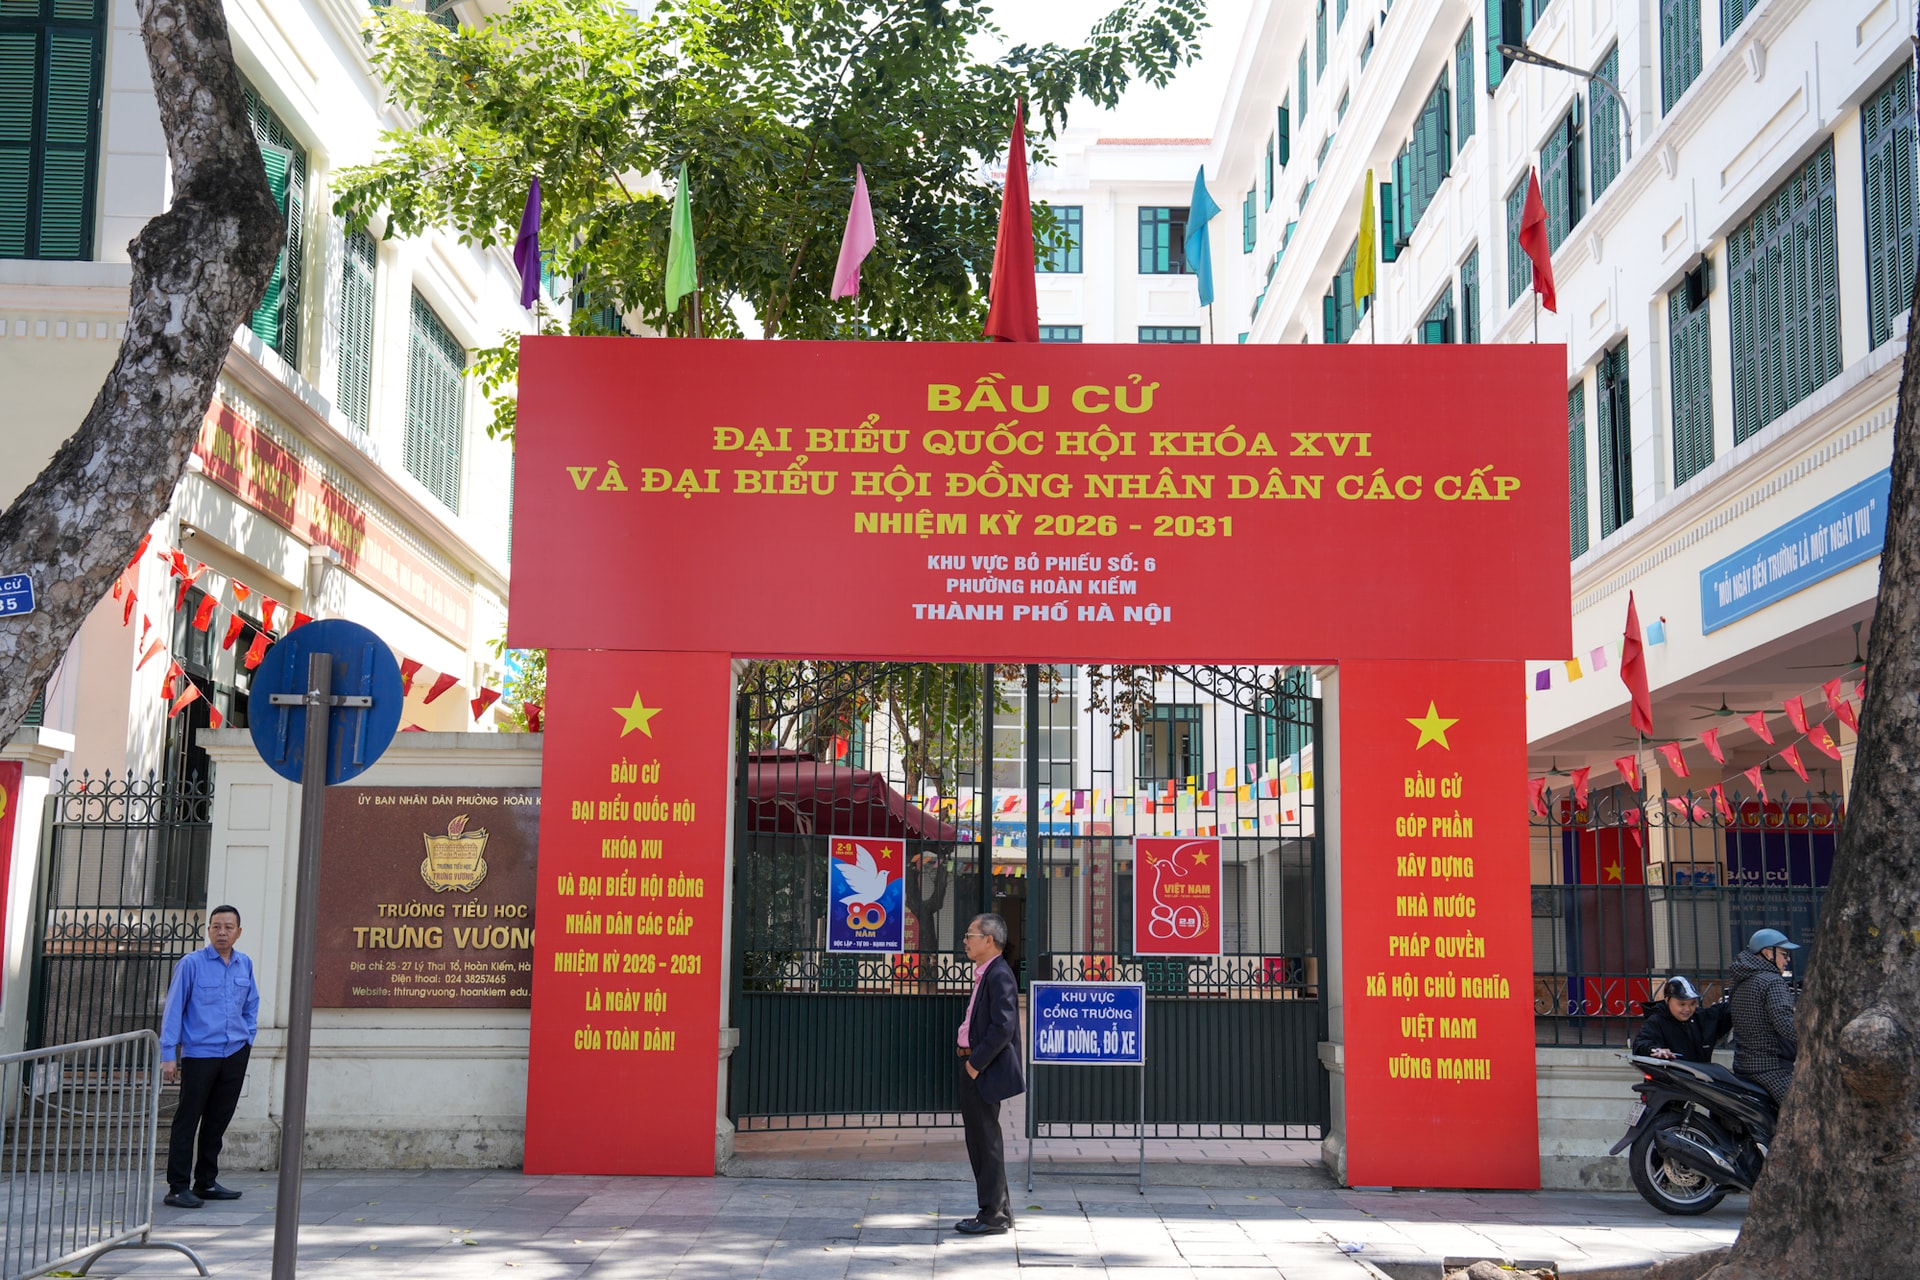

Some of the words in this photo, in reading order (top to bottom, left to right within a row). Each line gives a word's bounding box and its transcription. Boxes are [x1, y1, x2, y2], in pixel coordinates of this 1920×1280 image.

[928, 373, 1049, 413] BẦU
[1072, 374, 1160, 413] CỬ
[713, 427, 792, 457] ĐẠI
[805, 413, 909, 453] BIỂU
[922, 419, 1044, 456] QUỐC
[1056, 424, 1136, 462] HỘI
[1149, 424, 1277, 456] KHÓA
[1290, 433, 1372, 456] XVI
[566, 460, 628, 491] VÀ
[641, 468, 720, 499] ĐẠI
[734, 455, 838, 495] BIỂU
[851, 464, 931, 502] HỘI
[945, 460, 1073, 498] ĐỒNG
[1084, 467, 1215, 498] NHÂN
[1228, 467, 1324, 499] DÂN
[1336, 468, 1422, 500] CÁC
[1434, 464, 1521, 500] CẤP
[855, 509, 966, 538] NHIỆM
[980, 510, 1022, 535] KỲ
[1034, 515, 1117, 536] 2026
[1154, 516, 1232, 536] 2031
[928, 555, 965, 570] KHU
[972, 555, 1008, 573] VỰC
[1015, 552, 1039, 570] BỎ
[1046, 552, 1101, 571] PHIẾU
[1108, 552, 1138, 571] SỐ:
[1145, 558, 1155, 571] 6
[1733, 565, 1751, 600] NGÀY
[1752, 553, 1767, 591] ĐẾN
[1768, 543, 1798, 583] TRƯỜNG
[1799, 532, 1810, 566] LÀ
[1811, 524, 1829, 563] MỘT
[1830, 512, 1853, 553] NGÀY
[947, 576, 1024, 593] PHƯỜNG
[1031, 577, 1082, 594] HOÀN
[1089, 576, 1136, 594] KIẾM
[912, 601, 1003, 620] THÀNH
[1013, 600, 1068, 621] PHỐ
[1078, 603, 1114, 621] HÀ
[1124, 603, 1170, 625] NỘI
[611, 757, 637, 783] BẦU
[642, 759, 660, 784] CỬ
[1405, 770, 1435, 798] BẦU
[1441, 772, 1462, 798] CỬ
[359, 793, 371, 805] ỦY
[375, 796, 395, 805] BAN
[399, 794, 427, 804] NHÂN
[432, 794, 452, 805] DÂN
[457, 794, 498, 805] PHƯỜNG
[504, 794, 532, 805] HOÀN
[572, 801, 594, 824] ĐẠI
[599, 793, 629, 821] BIỂU
[634, 795, 668, 822] QUỐC
[673, 799, 695, 825] HỘI
[1396, 813, 1427, 837] GÓP
[1432, 810, 1472, 838] PHẦN
[602, 835, 637, 858] KHÓA
[1397, 853, 1426, 876] XÂY
[1432, 856, 1473, 881] DỰNG
[558, 872, 574, 895] VÀ
[579, 877, 601, 900] ĐẠI
[606, 869, 636, 896] BIỂU
[641, 874, 663, 901] HỘI
[668, 871, 703, 897] ĐỒNG
[1164, 882, 1186, 895] VIỆT
[1187, 884, 1211, 894] NAM
[378, 899, 444, 917] TRƯỜNG
[452, 898, 487, 917] TIỂU
[847, 901, 887, 931] 80
[1397, 892, 1428, 916] NHÀ
[1434, 893, 1475, 917] NƯỚC
[566, 911, 601, 934] NHÂN
[606, 911, 632, 934] DÂN
[637, 912, 662, 935] CÁC
[667, 909, 693, 935] CẤP
[353, 924, 445, 948] TRƯNG
[453, 925, 534, 949] VƯƠN
[1390, 932, 1430, 956] PHÁP
[1435, 930, 1484, 958] QUYỀN
[350, 962, 365, 972] Địa
[415, 961, 424, 972] Lý
[450, 959, 462, 972] Tổ,
[464, 961, 488, 971] Hoàn
[491, 960, 516, 972] Kiếm,
[519, 962, 531, 971] Hà
[555, 949, 598, 976] NHIỆM
[603, 949, 620, 972] KỲ
[623, 954, 656, 973] 2026
[671, 954, 701, 974] 2031
[352, 987, 390, 996] Website:
[391, 974, 411, 985] Điện
[445, 974, 461, 983] 024
[465, 974, 506, 983] 38257465
[1367, 972, 1386, 996] XÃ
[1392, 972, 1418, 1001] HỘI
[1425, 971, 1455, 998] CHỦ
[1462, 974, 1509, 998] NGHĨA
[586, 987, 601, 1011] LÀ
[606, 988, 640, 1011] NGÀY
[644, 988, 666, 1016] HỘI
[1043, 1003, 1078, 1018] CỔNG
[1082, 1007, 1132, 1019] TRƯỜNG
[1061, 992, 1086, 1002] KHU
[1090, 992, 1115, 1005] VỰC
[575, 1024, 600, 1049] CỦA
[606, 1027, 639, 1050] TOÀN
[644, 1027, 675, 1051] DÂN!
[1040, 1021, 1064, 1055] CẤM
[1068, 1025, 1100, 1056] DỪNG,
[1103, 1022, 1118, 1054] ĐỖ
[1121, 1031, 1135, 1054] XE
[1401, 1013, 1434, 1042] VIỆT
[1440, 1018, 1476, 1038] NAM
[1389, 1053, 1431, 1078] VỮNG
[1437, 1058, 1490, 1084] MẠNH!
